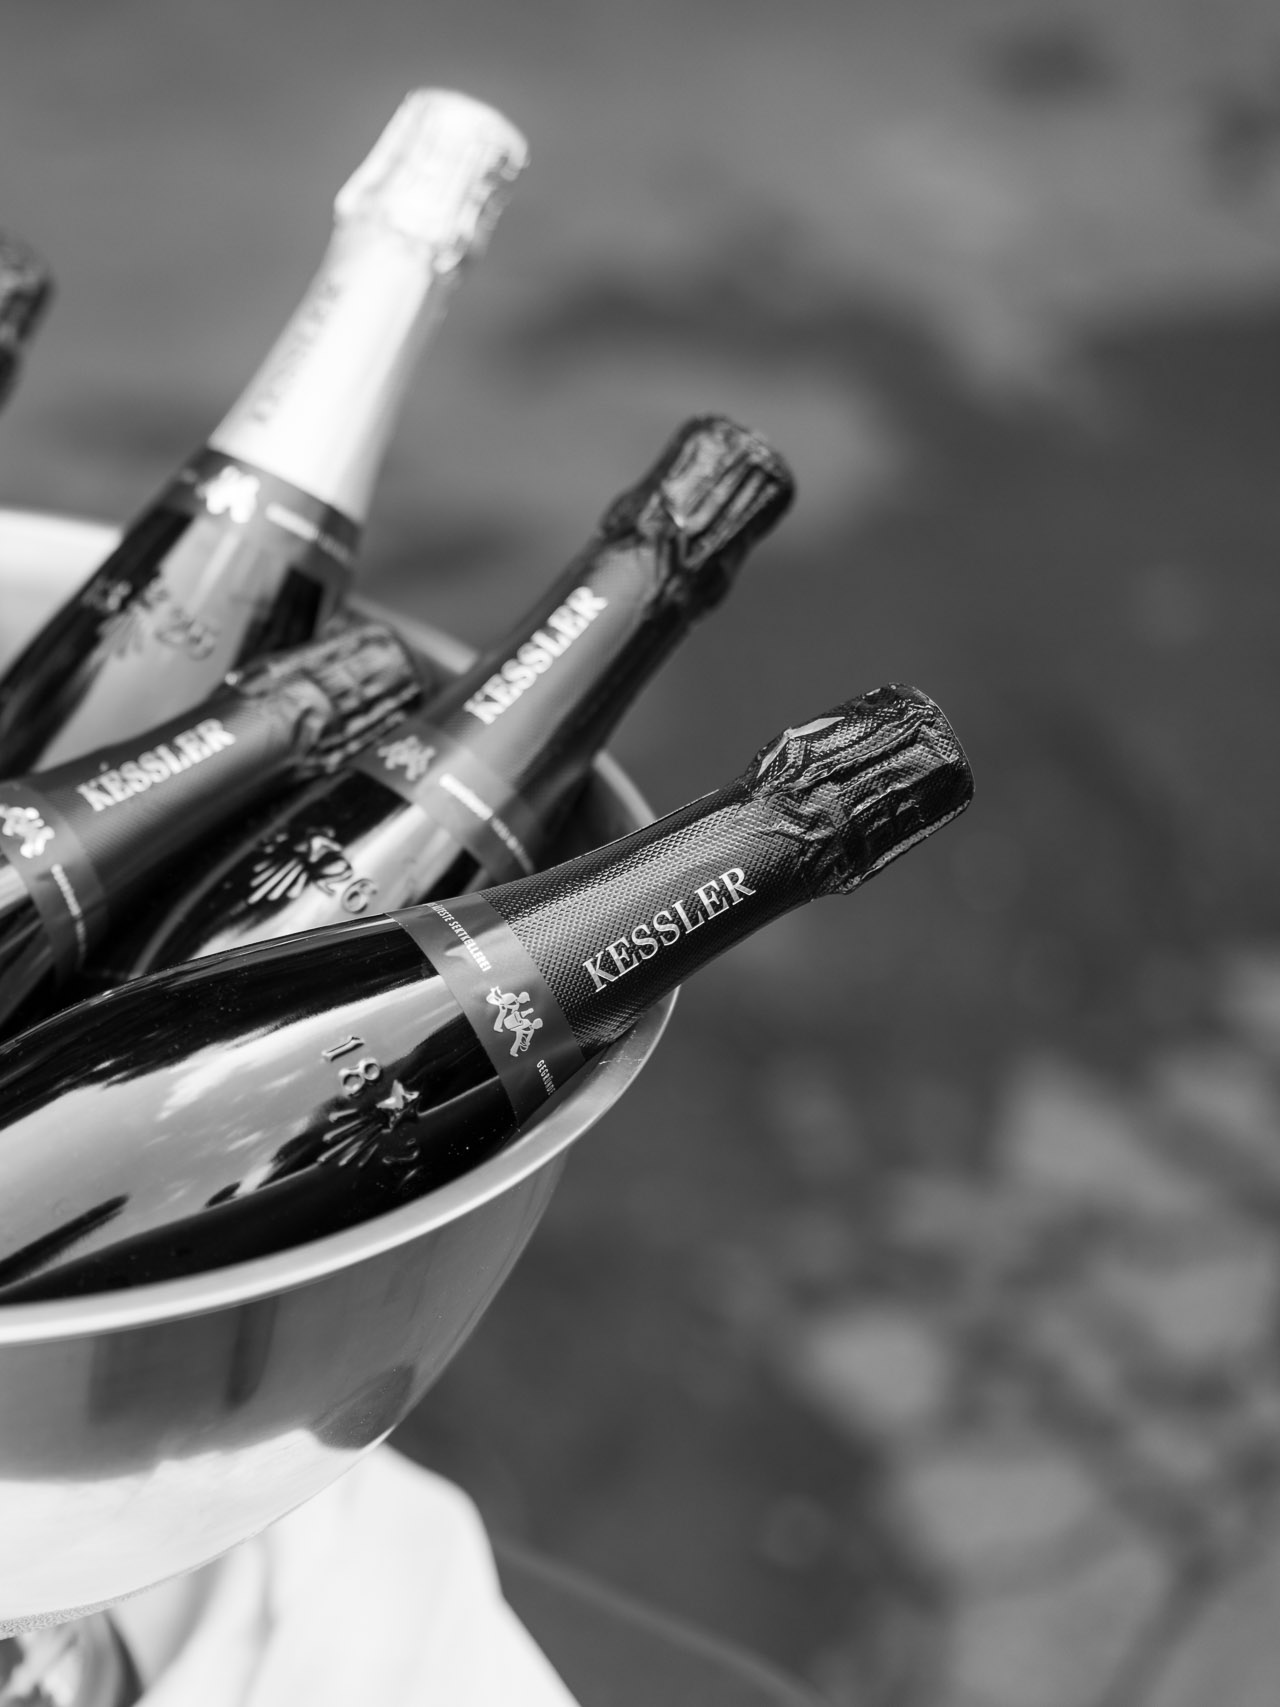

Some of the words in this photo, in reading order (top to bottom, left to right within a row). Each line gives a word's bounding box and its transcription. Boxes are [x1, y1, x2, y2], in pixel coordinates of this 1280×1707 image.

[463, 585, 609, 725] KESSLER
[77, 718, 237, 812] KESSLER
[448, 920, 492, 972] SEKTKELLEREI
[582, 866, 757, 993] KESSLER
